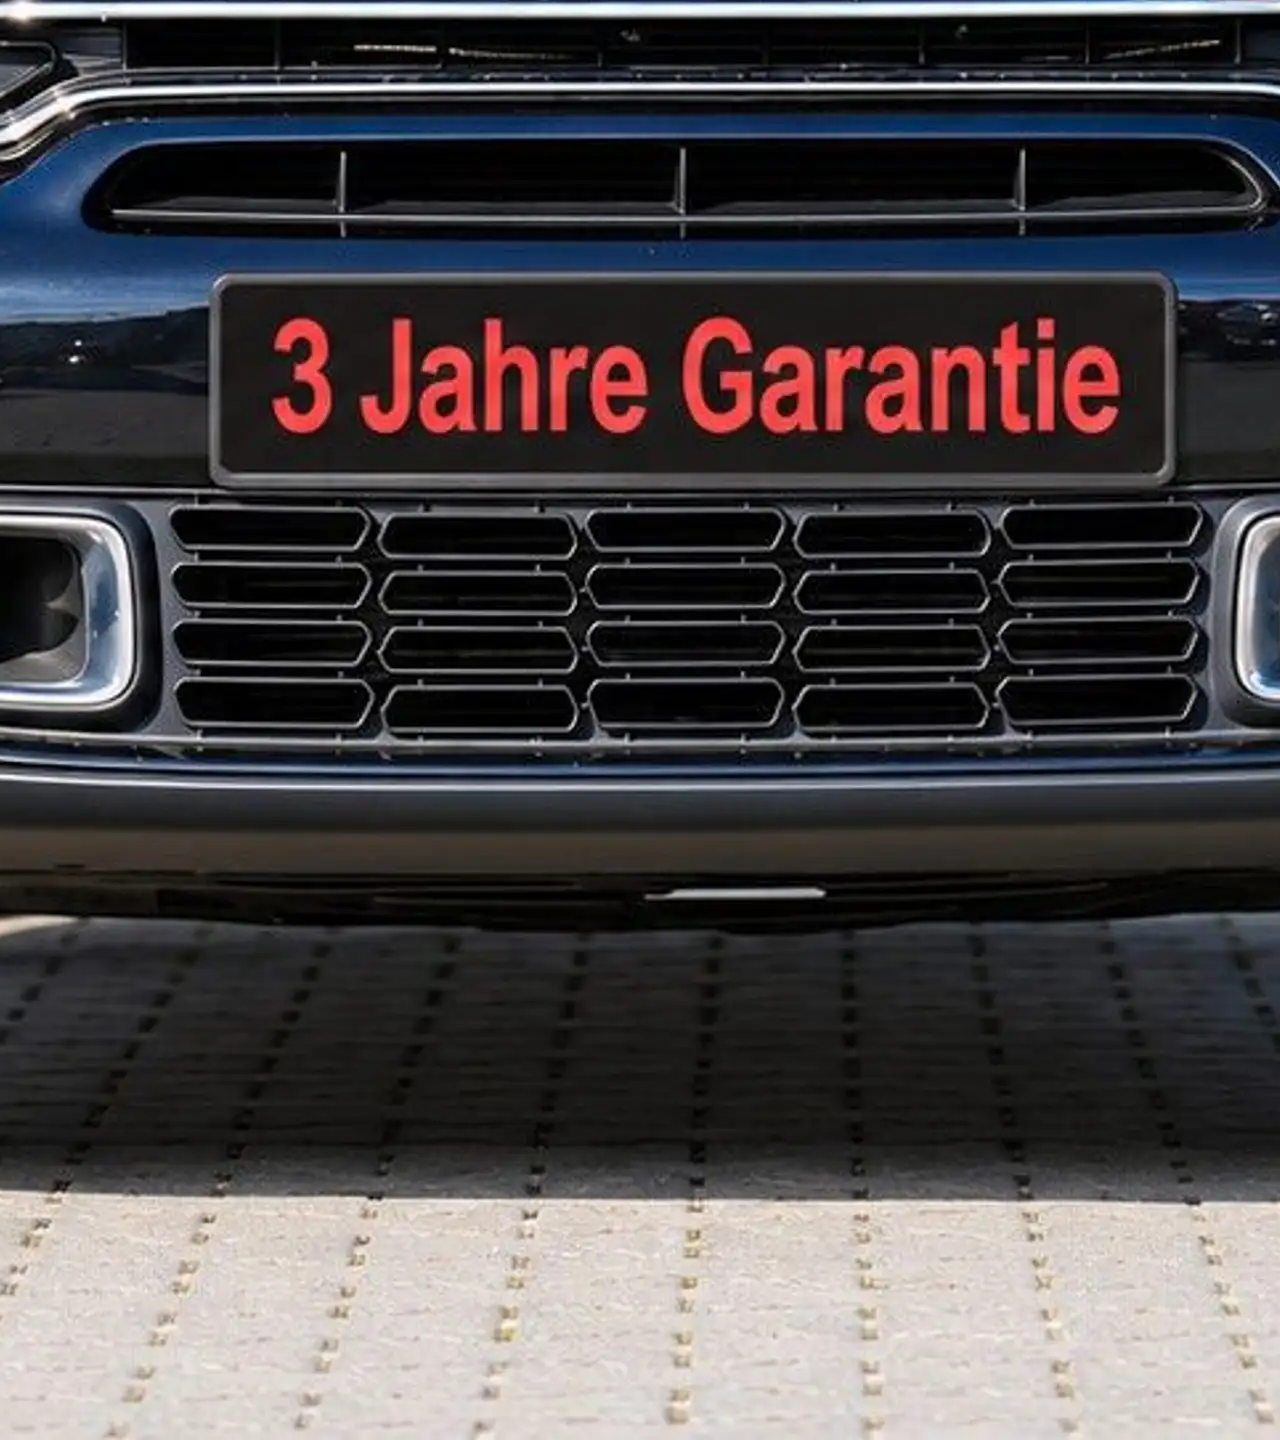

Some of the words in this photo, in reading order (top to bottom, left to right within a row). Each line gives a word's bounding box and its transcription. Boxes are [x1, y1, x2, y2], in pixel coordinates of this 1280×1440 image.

[273, 318, 332, 434] 3
[360, 318, 648, 434] Jahre
[682, 317, 1120, 434] Garantie
